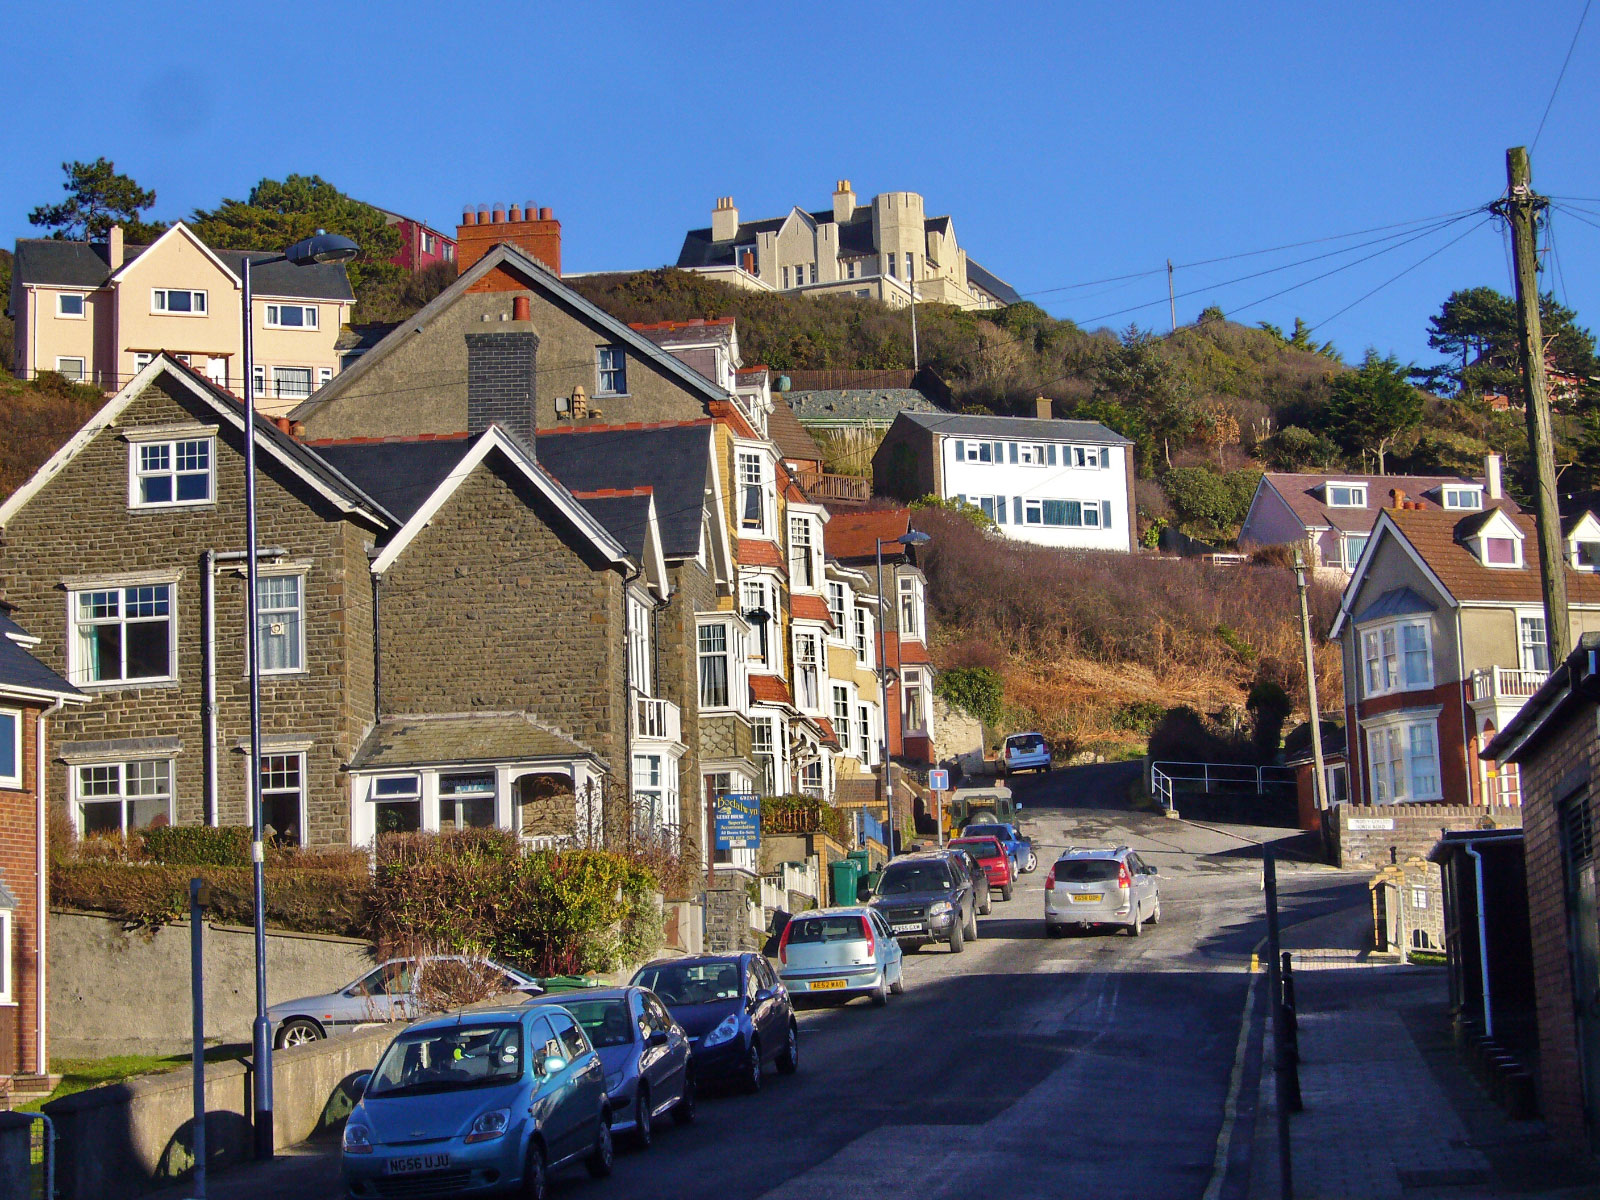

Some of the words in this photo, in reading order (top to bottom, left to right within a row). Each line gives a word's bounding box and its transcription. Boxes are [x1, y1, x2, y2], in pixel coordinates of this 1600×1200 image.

[717, 796, 758, 818] Bodalwyn
[389, 1158, 422, 1173] NG56
[424, 1153, 450, 1169] UJU
